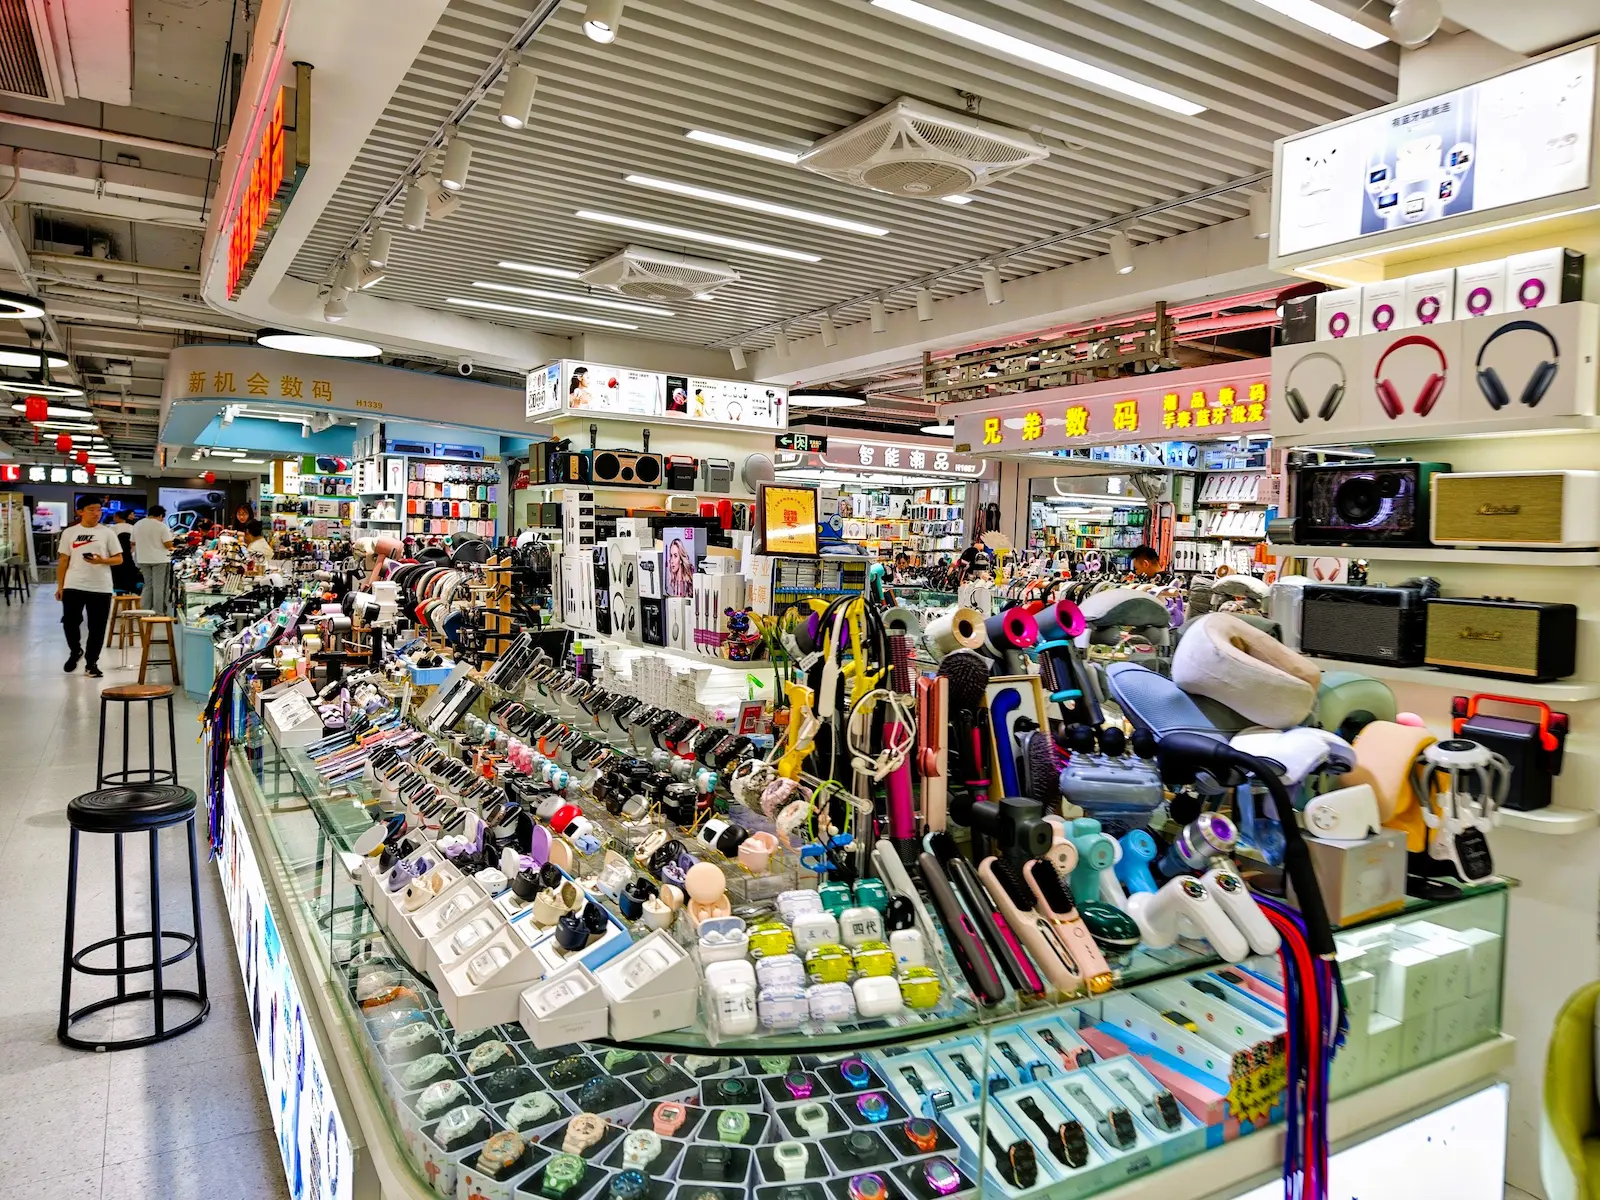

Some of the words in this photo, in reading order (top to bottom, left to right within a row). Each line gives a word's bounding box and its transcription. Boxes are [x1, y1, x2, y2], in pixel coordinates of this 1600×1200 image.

[189, 371, 332, 401] 新机会数码
[356, 399, 383, 409] H1339
[1162, 402, 1264, 429] 手表蓝牙批发
[983, 400, 1138, 445] 兄弟数码
[859, 445, 949, 470] 智能潮品
[853, 921, 877, 935] 四代
